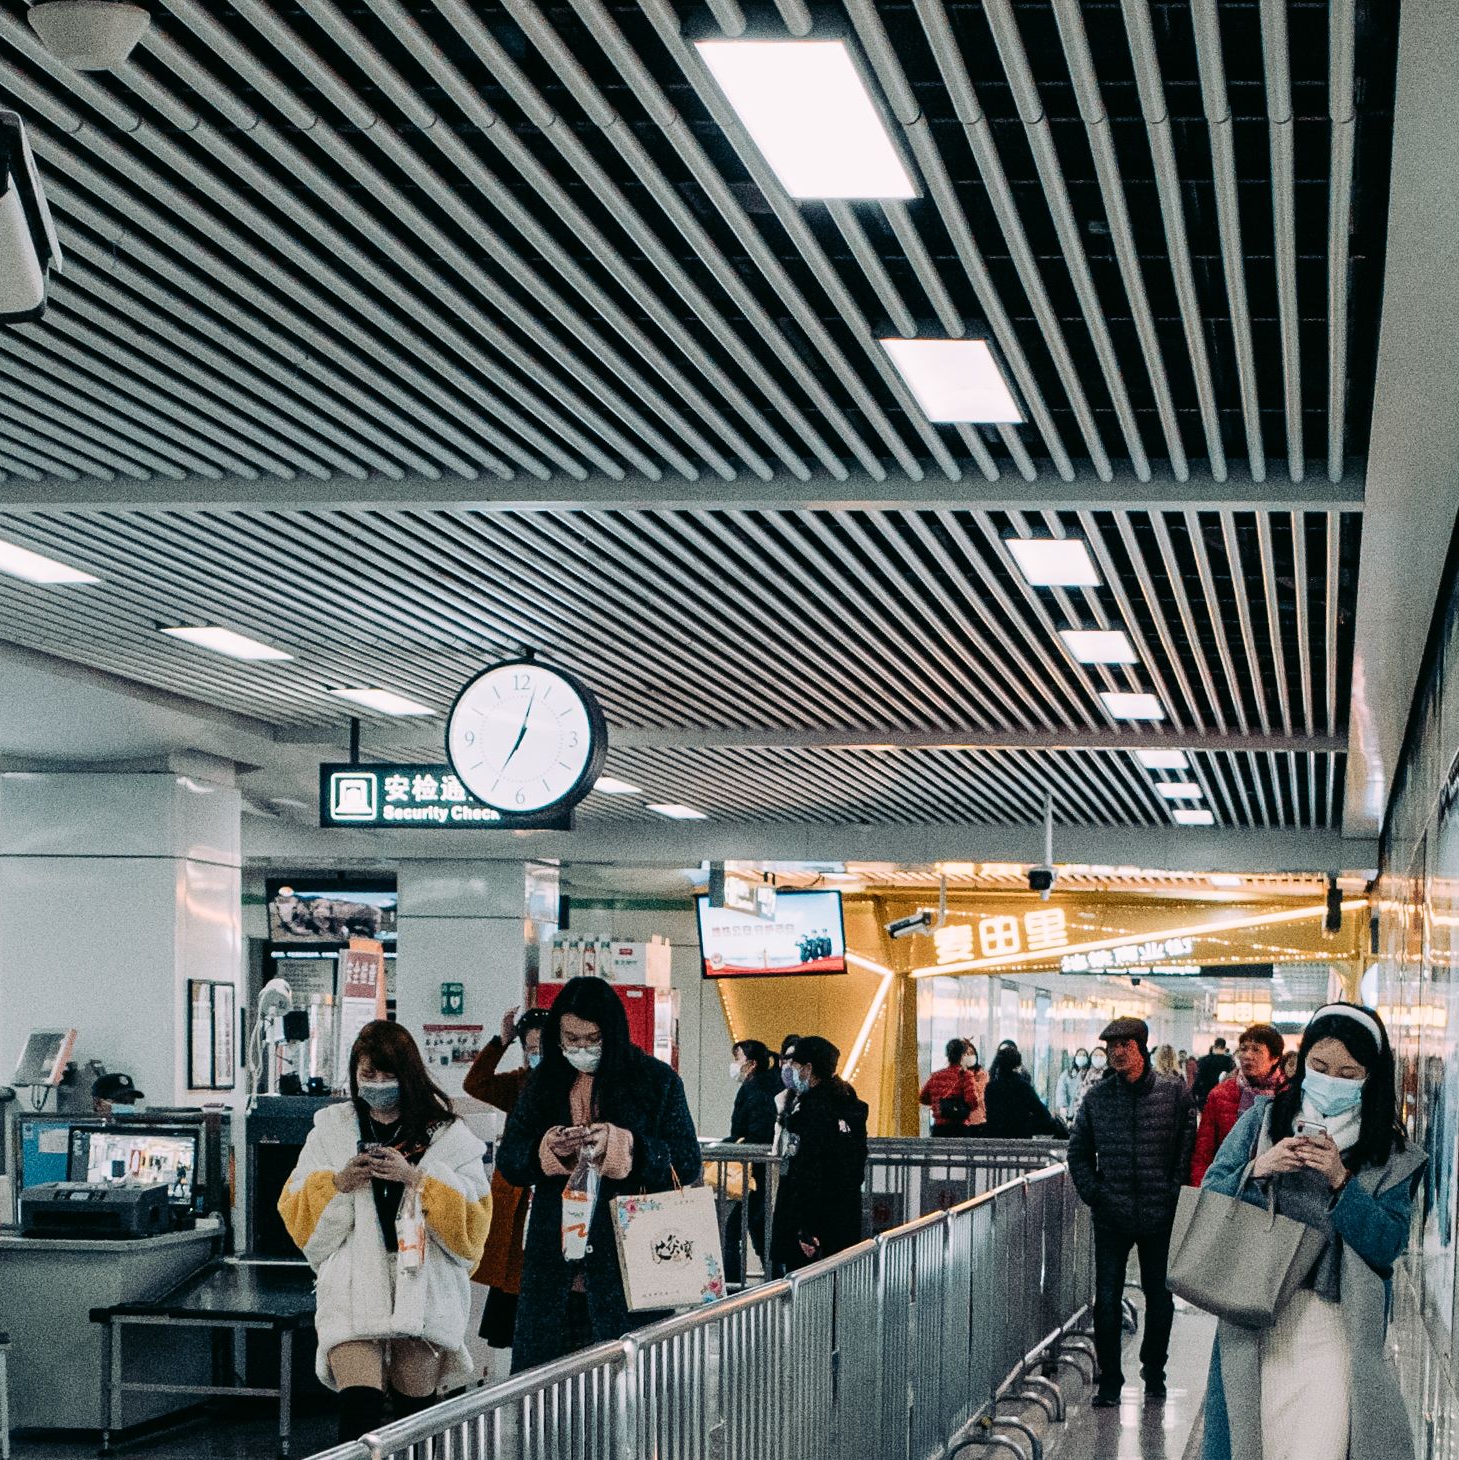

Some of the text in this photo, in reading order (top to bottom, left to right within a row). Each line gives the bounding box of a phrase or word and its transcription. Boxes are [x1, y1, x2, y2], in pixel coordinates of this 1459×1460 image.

[513, 674, 531, 691] 12
[465, 731, 475, 747] 9
[570, 731, 579, 748] 3
[383, 773, 474, 803] 安检通
[516, 787, 525, 804] 6
[382, 804, 450, 824] Security
[933, 907, 1069, 965] 麦田里
